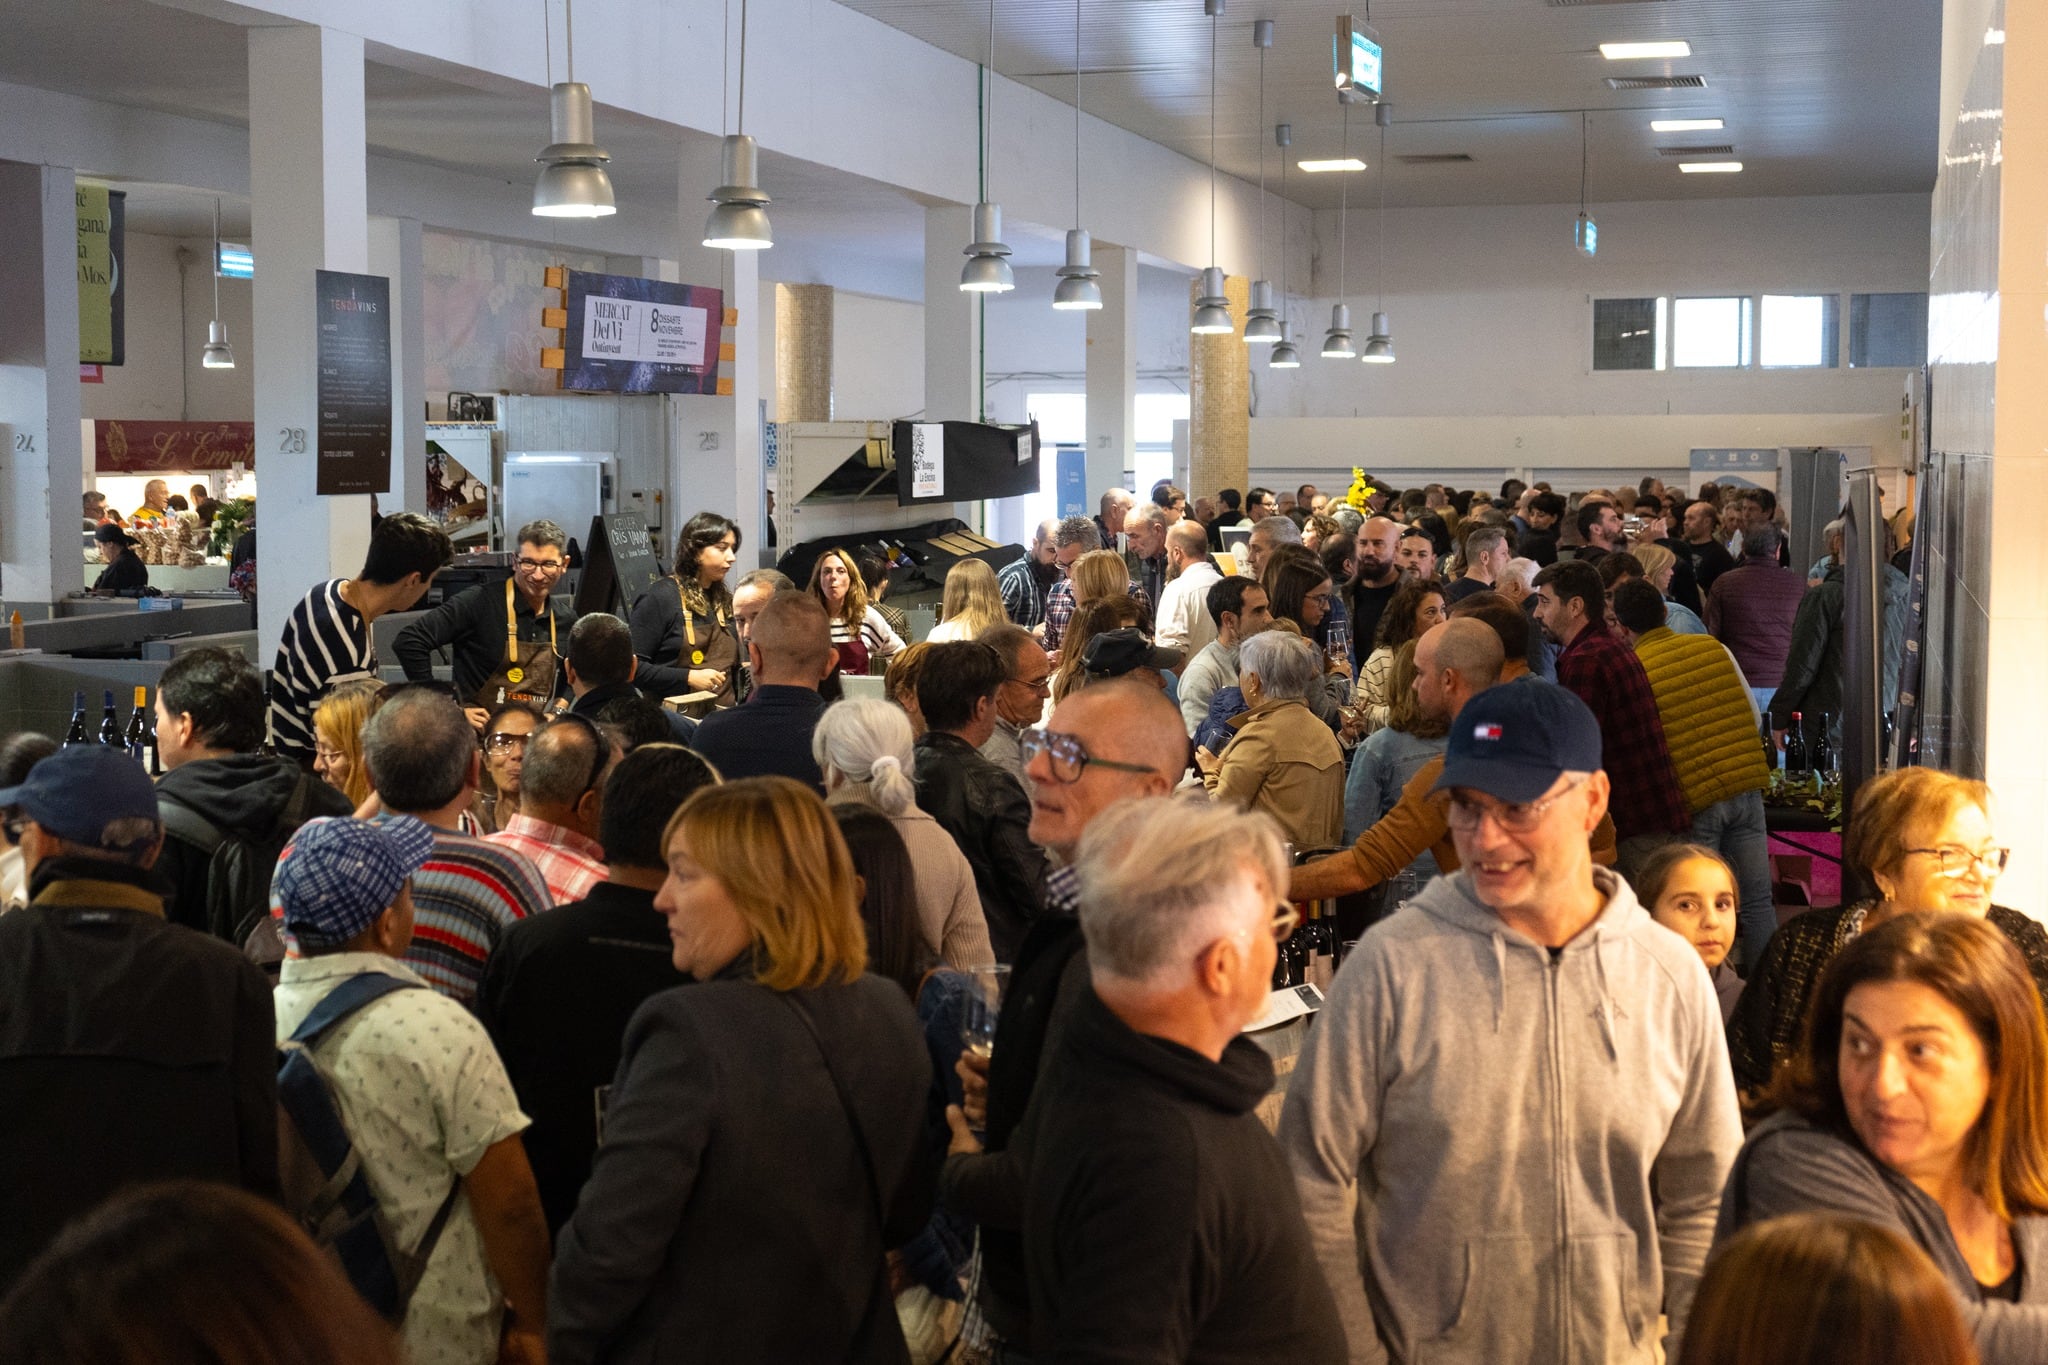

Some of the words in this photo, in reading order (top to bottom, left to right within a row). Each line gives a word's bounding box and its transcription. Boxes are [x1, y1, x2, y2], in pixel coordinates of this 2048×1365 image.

[331, 299, 377, 312] TENDAVINS
[594, 301, 632, 320] MERCAT
[593, 319, 610, 340] Del
[611, 320, 623, 341] Vi
[650, 308, 659, 333] 8
[15, 433, 35, 453] 24
[279, 427, 306, 454] 28
[506, 692, 548, 703] TENDAVINS
